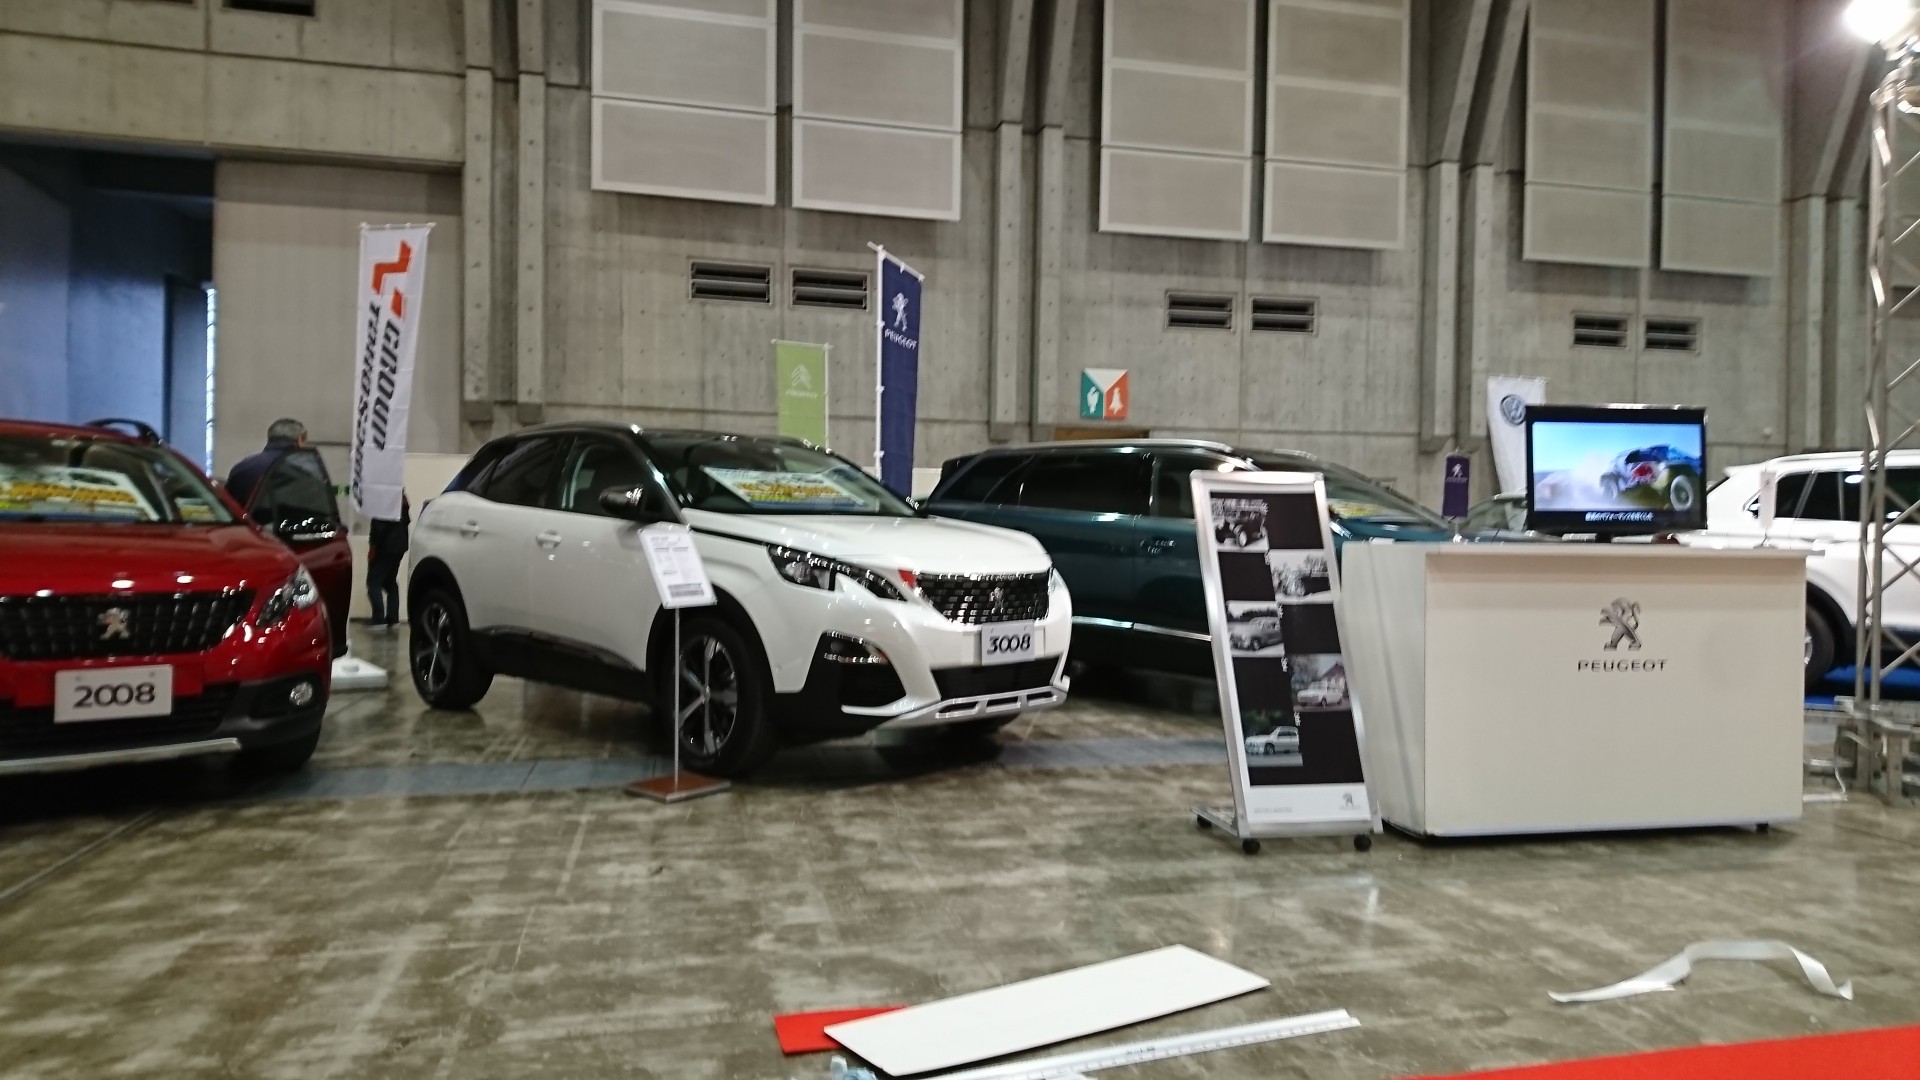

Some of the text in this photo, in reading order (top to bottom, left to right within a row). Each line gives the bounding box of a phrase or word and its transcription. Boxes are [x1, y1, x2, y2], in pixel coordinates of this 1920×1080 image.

[371, 318, 401, 451] GROUP
[987, 633, 1031, 655] 3008
[1578, 659, 1668, 673] PEUGEOT
[73, 682, 156, 710] 2008
